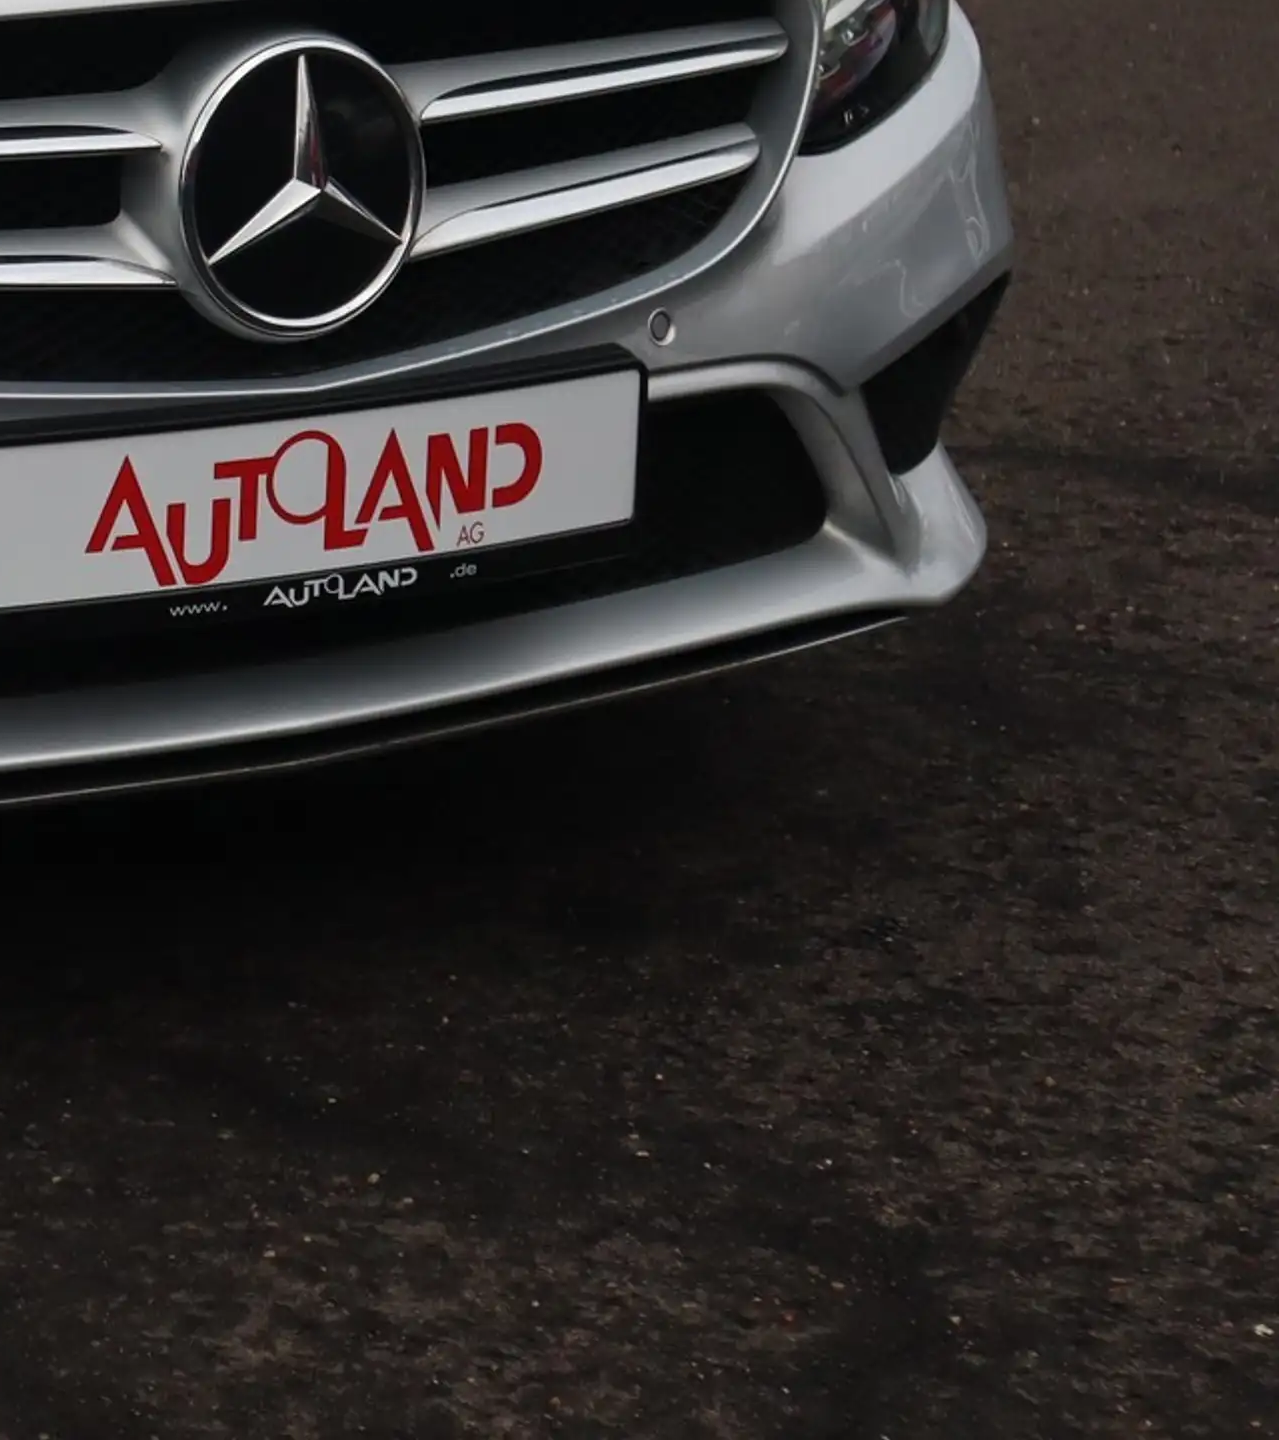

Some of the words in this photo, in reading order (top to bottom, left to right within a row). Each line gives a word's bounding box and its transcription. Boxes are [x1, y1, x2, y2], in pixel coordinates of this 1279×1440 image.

[85, 422, 543, 587] AUTOLAND
[455, 521, 486, 547] AG
[168, 599, 228, 618] www.
[262, 566, 419, 609] AUTOLAND
[449, 562, 478, 579] .de
